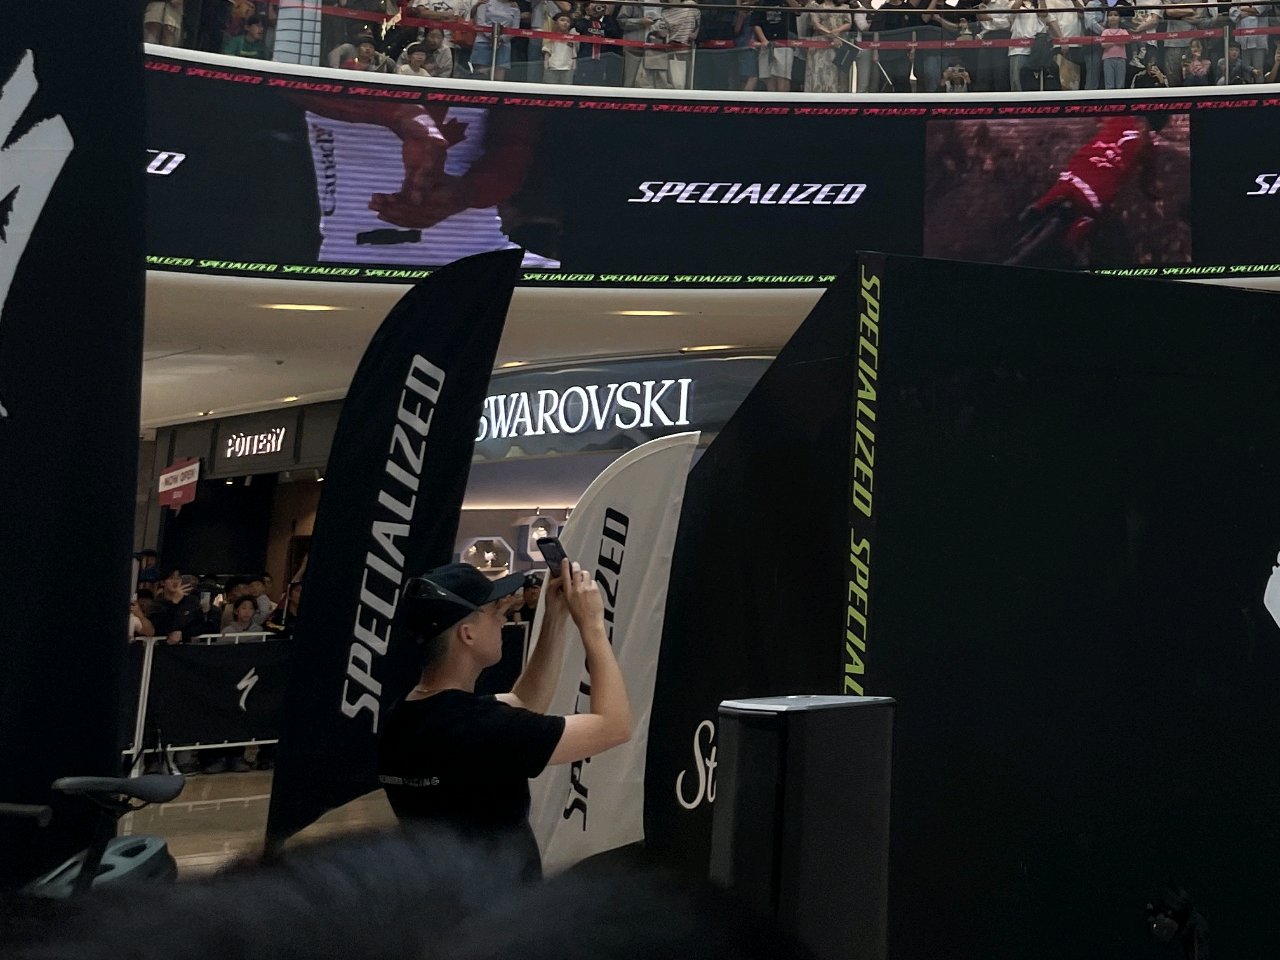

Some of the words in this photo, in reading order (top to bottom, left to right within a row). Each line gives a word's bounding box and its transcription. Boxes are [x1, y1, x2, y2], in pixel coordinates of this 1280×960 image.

[628, 180, 867, 206] SPECIALIZED
[200, 259, 278, 272] SPECIALIZED
[282, 264, 359, 276] SPECIALIZED
[523, 272, 595, 281] SPECIALIZED
[599, 273, 670, 282] SPECIALIZED
[673, 274, 742, 283] SPECIALIZED
[746, 275, 814, 283] SPECIALIZED
[1162, 266, 1225, 275] SPECIALIZED
[475, 378, 692, 442] SWAROVSKI
[851, 264, 881, 518] SPECIALIZED
[340, 353, 446, 734] SPECIALIZED
